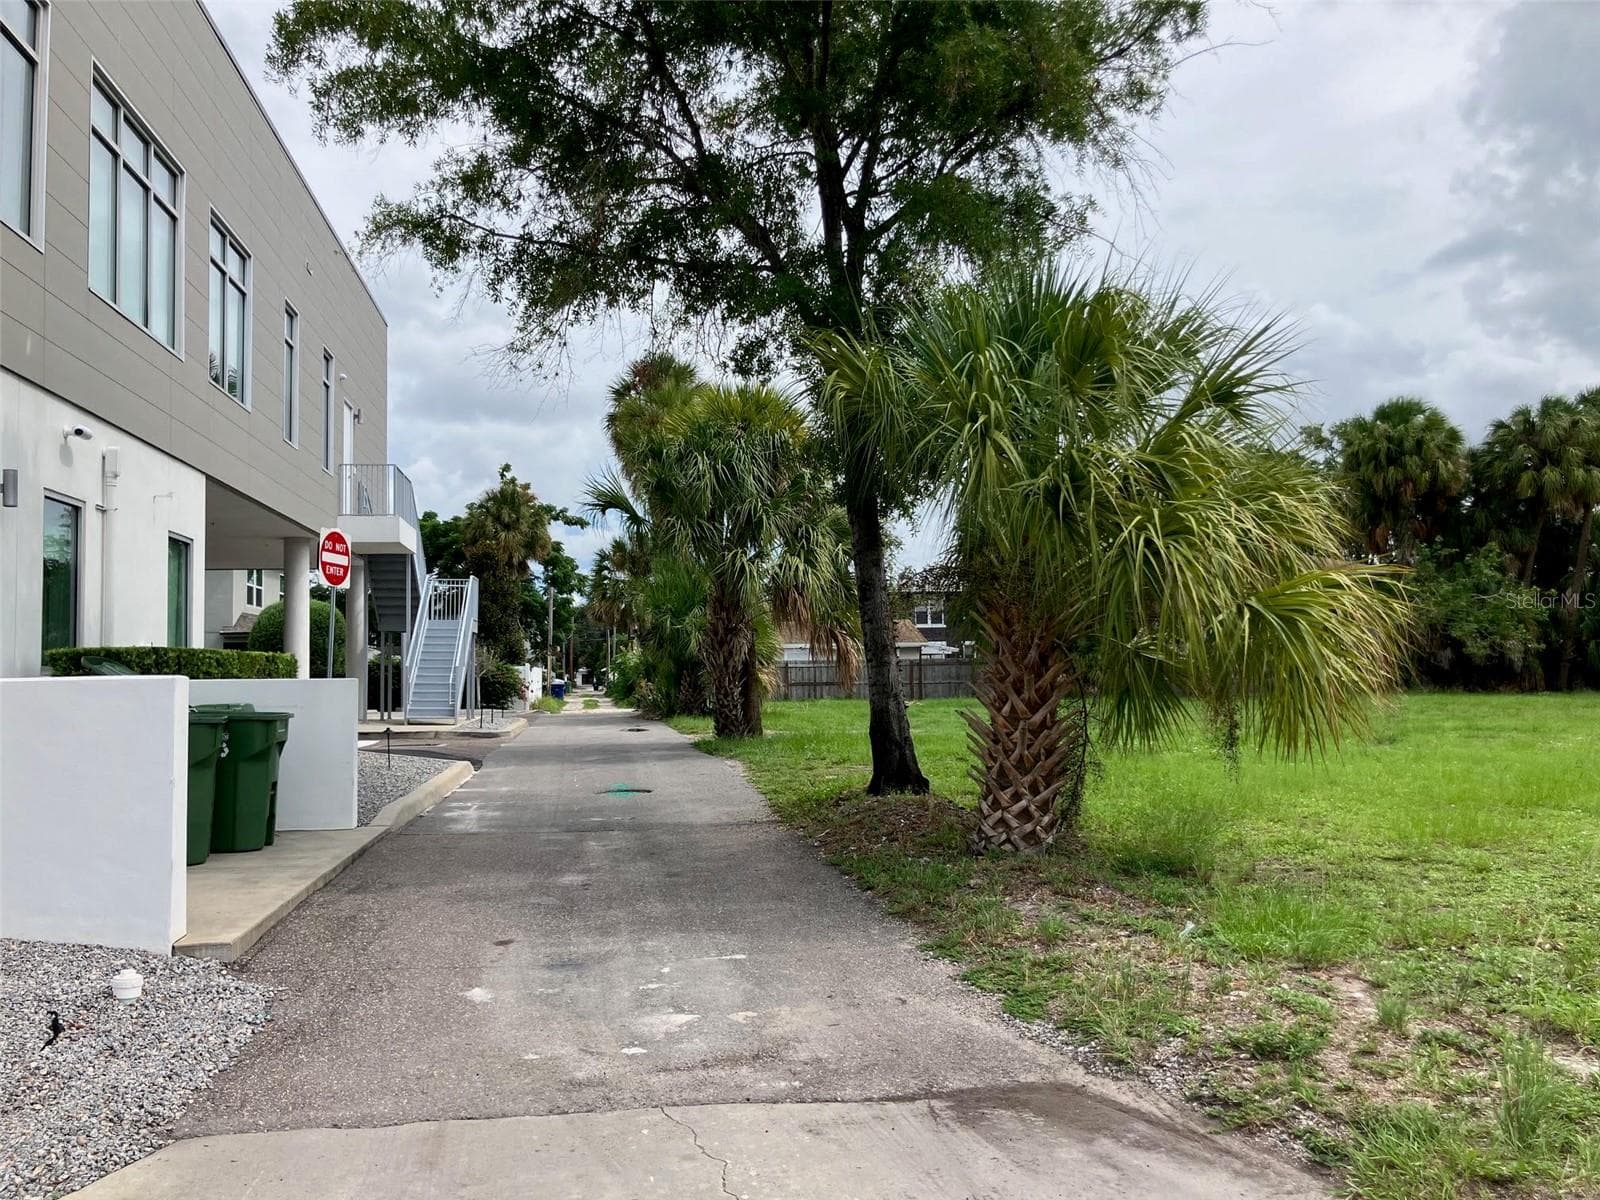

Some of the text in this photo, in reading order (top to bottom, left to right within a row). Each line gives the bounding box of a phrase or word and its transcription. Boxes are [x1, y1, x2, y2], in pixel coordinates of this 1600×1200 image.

[324, 540, 346, 552] DO NOT
[326, 565, 344, 576] ENTER
